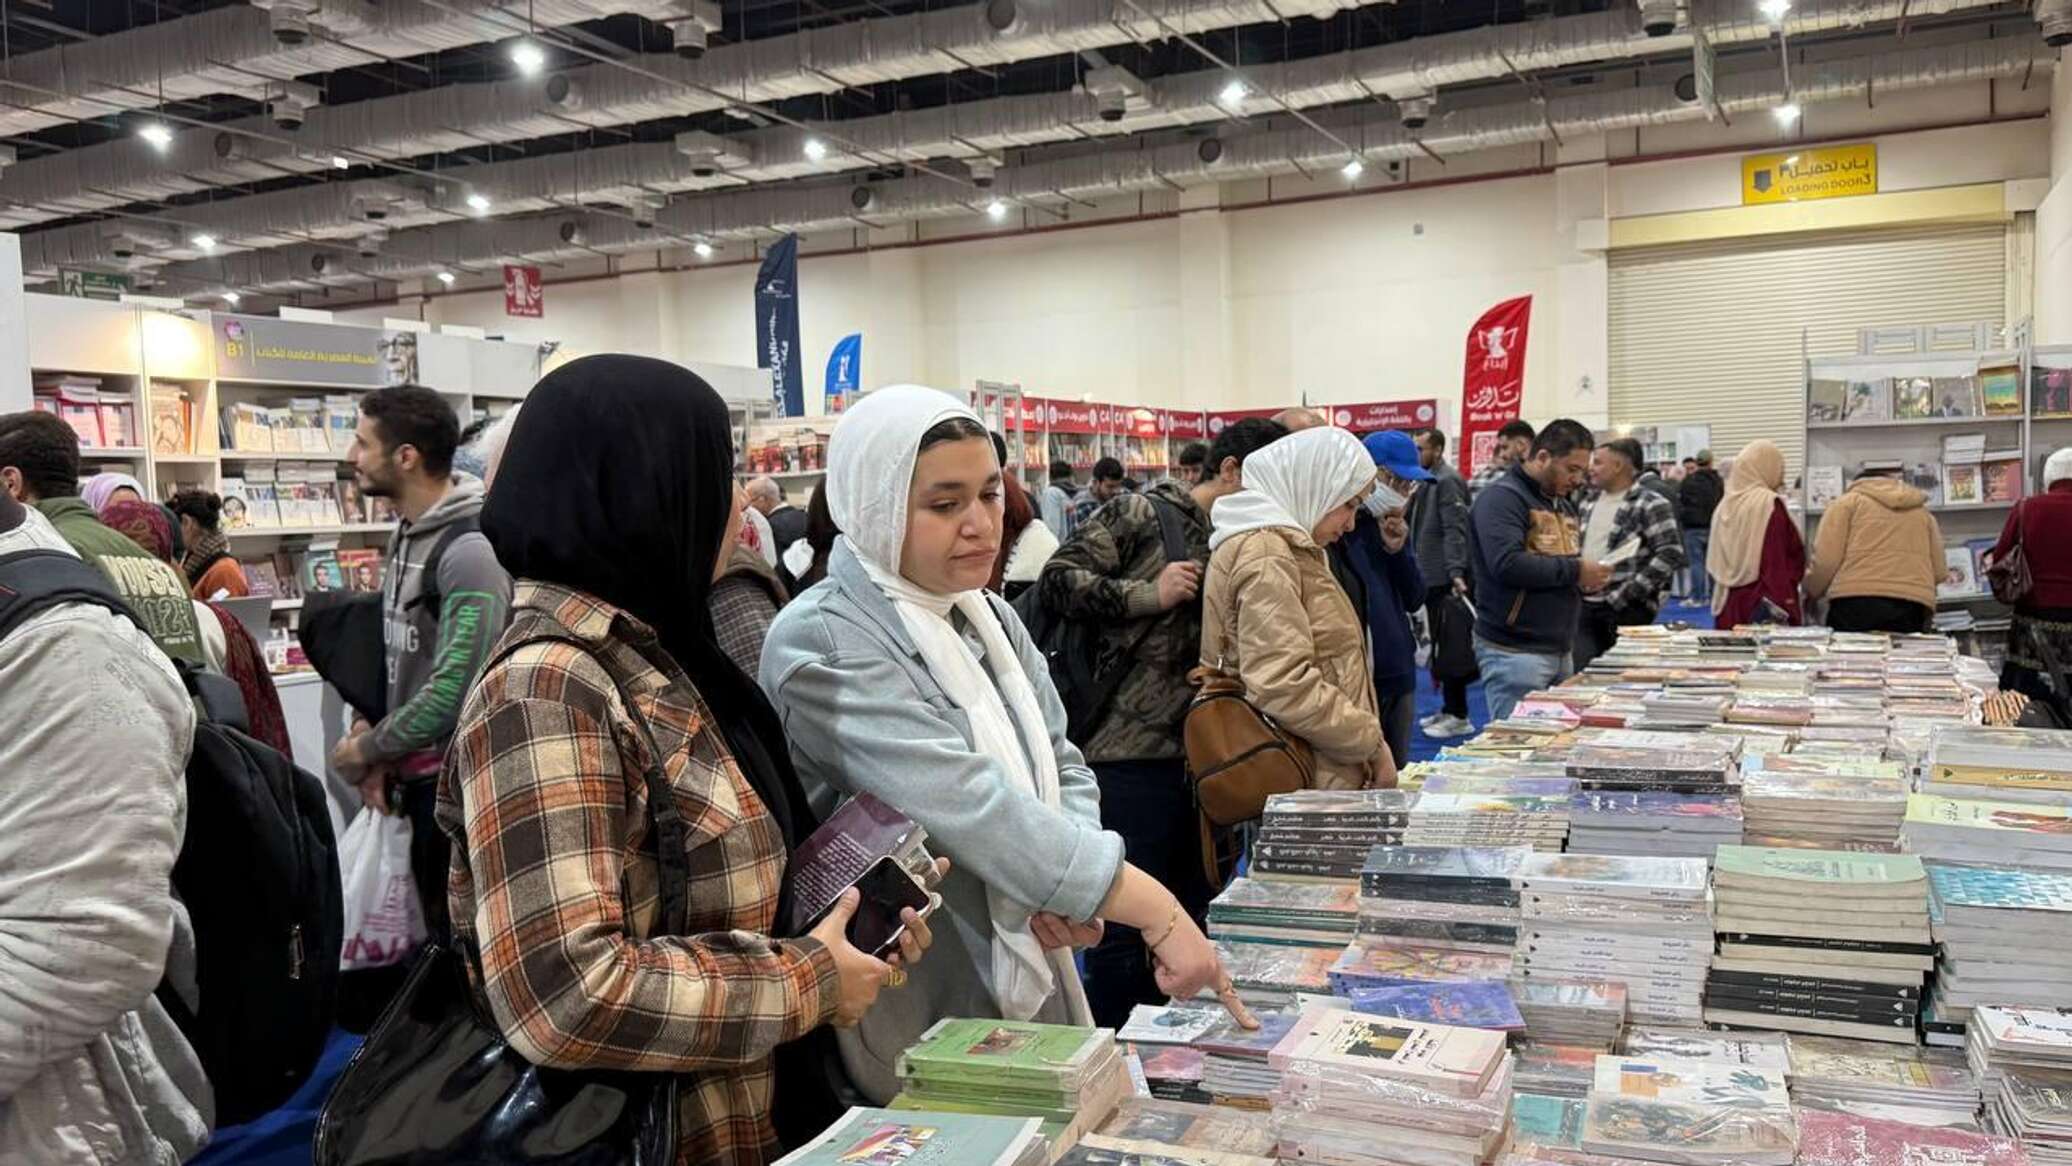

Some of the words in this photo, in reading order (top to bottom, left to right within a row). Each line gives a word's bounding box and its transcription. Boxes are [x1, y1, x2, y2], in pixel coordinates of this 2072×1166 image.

[1780, 181, 1830, 196] LOADING
[1831, 176, 1863, 189] DOOR
[1863, 173, 1872, 186] 3
